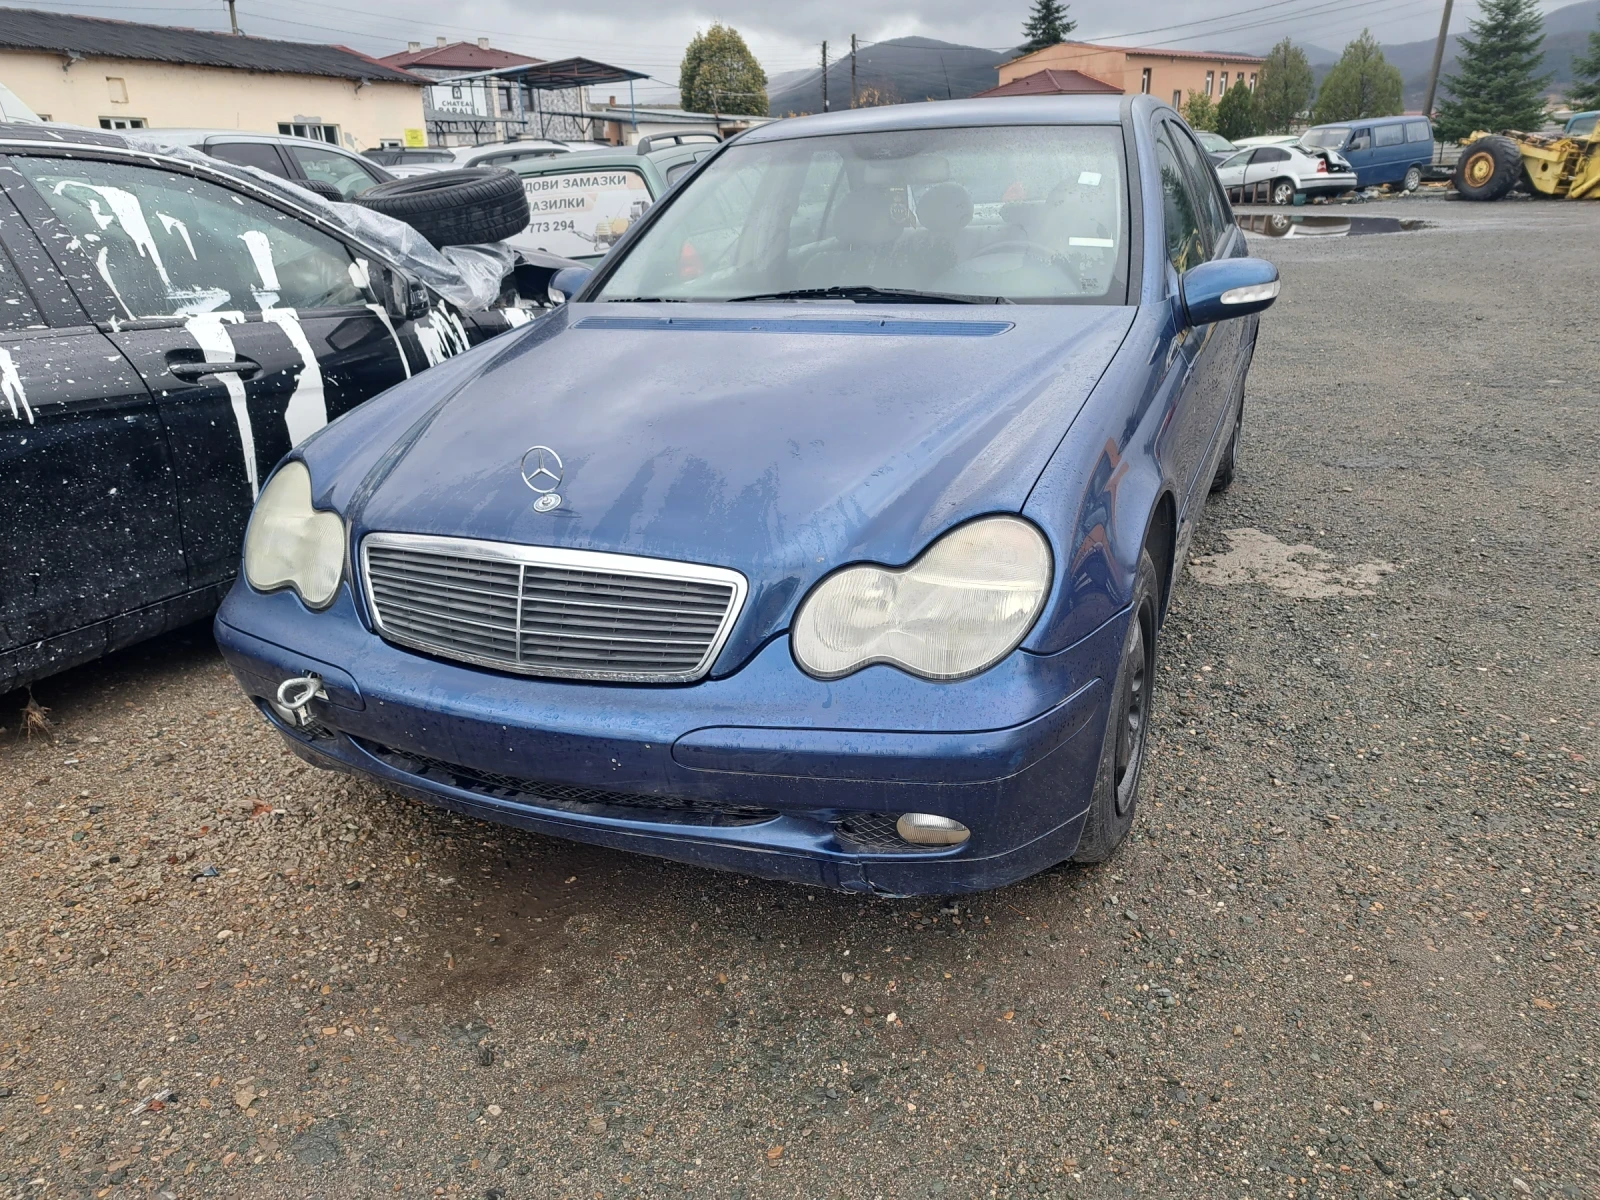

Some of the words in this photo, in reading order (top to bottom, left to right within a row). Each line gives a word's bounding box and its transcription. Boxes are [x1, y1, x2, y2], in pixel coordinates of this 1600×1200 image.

[525, 180, 558, 194] ДОВИ
[562, 175, 627, 189] ЗАМАЗКИ
[553, 220, 574, 231] 294
